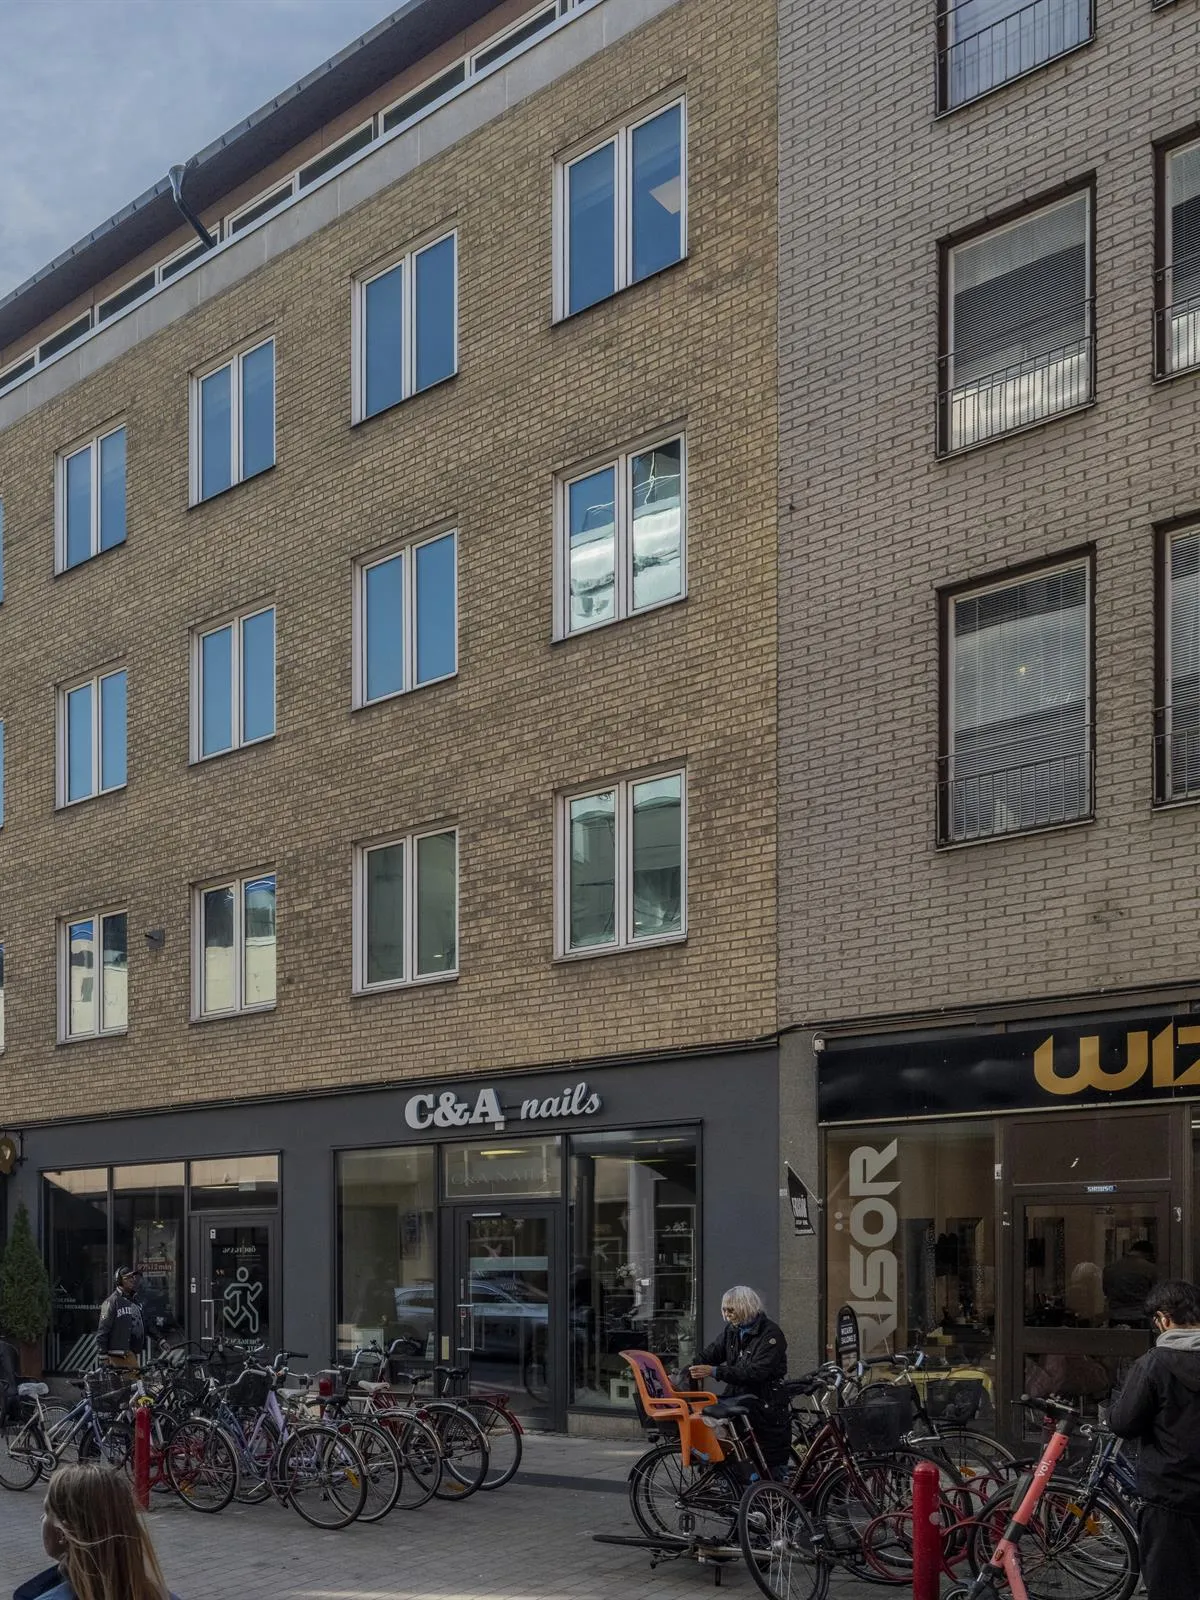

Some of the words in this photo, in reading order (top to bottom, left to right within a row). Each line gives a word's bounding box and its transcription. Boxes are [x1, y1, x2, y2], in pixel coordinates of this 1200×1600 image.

[404, 1088, 504, 1129] C&A
[520, 1081, 603, 1120] nails
[834, 1137, 902, 1366] RISÖR
